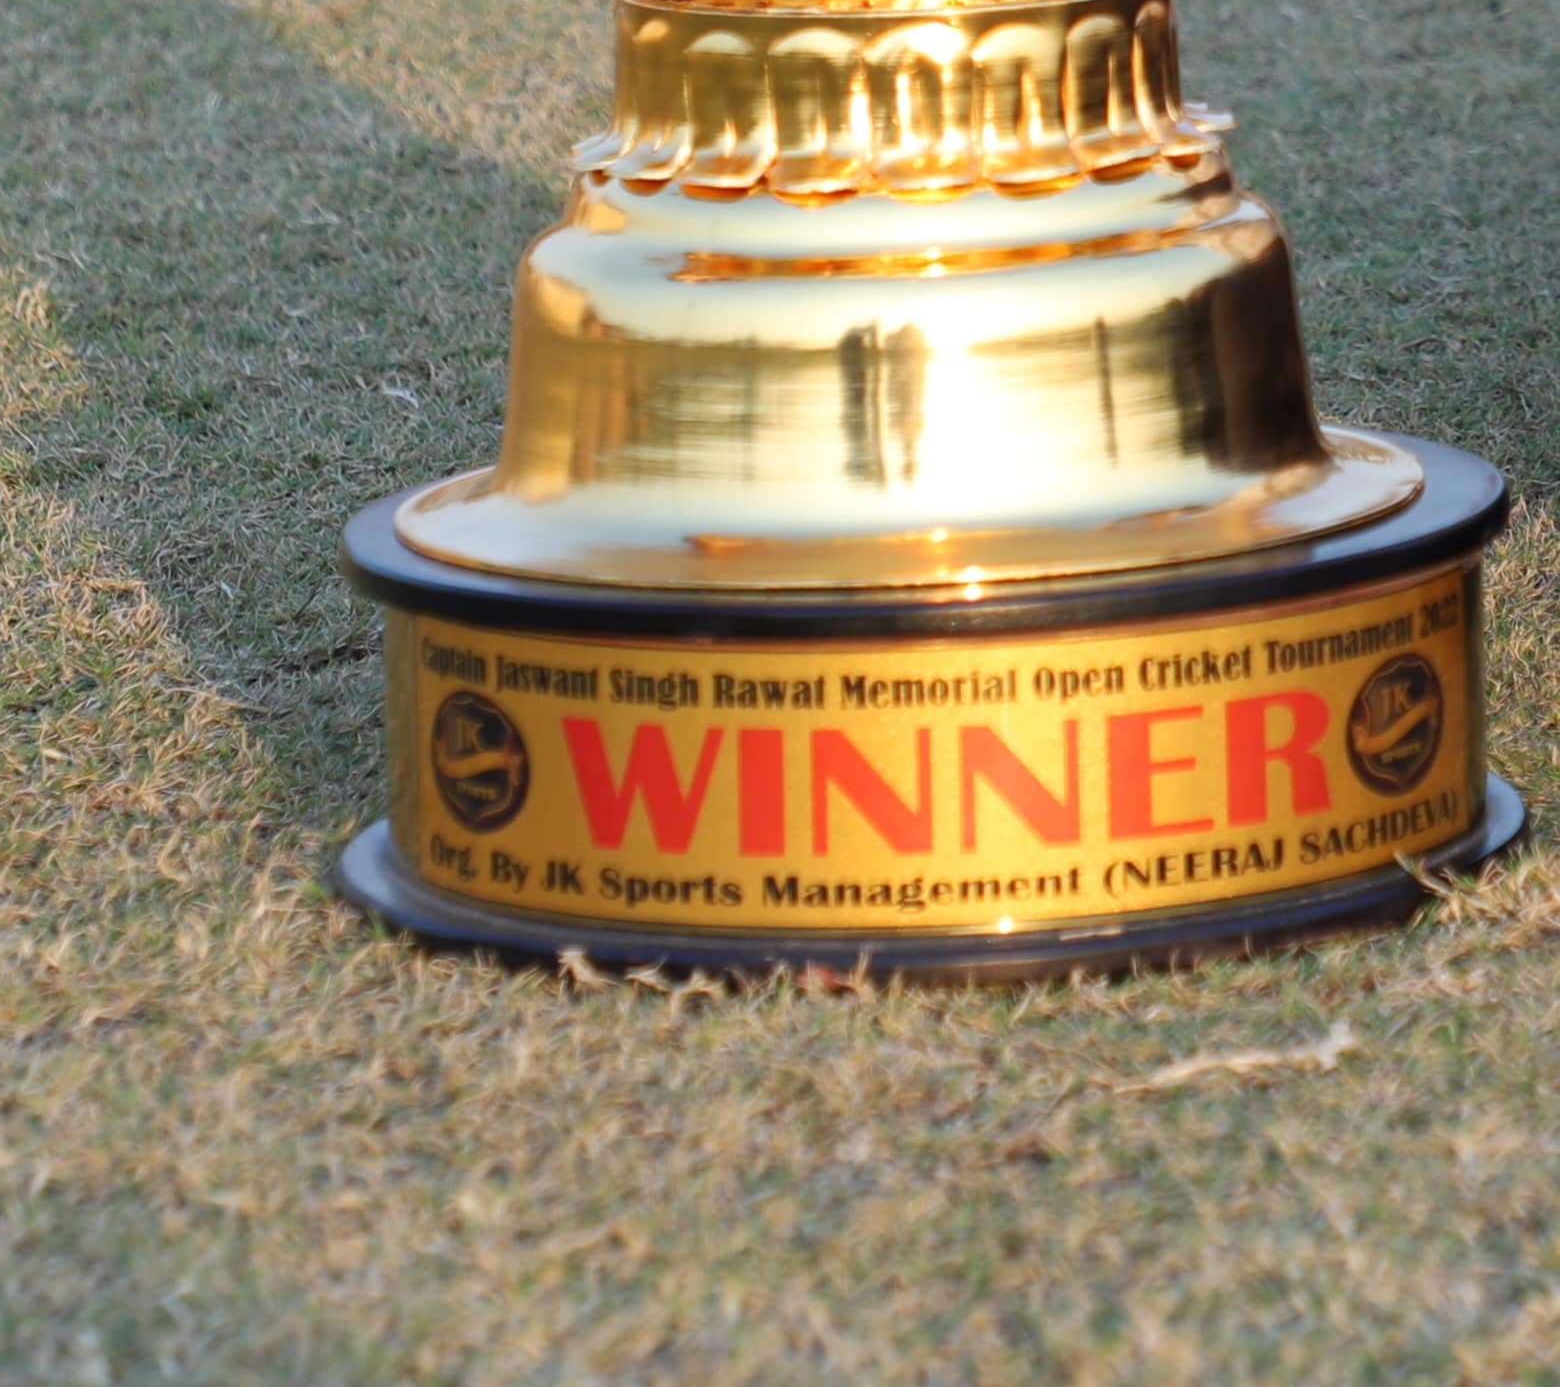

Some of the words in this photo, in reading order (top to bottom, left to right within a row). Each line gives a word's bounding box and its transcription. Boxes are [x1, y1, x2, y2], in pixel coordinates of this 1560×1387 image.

[495, 653, 599, 701] Jaswant
[609, 667, 700, 711] Singh
[712, 674, 826, 711] Rawat
[840, 669, 1018, 711] Memorial
[1033, 663, 1125, 705] Open
[1139, 642, 1252, 693] Cricket
[1263, 609, 1414, 676] Tournament
[560, 689, 1334, 858] WINNER
[430, 835, 477, 882] Org.
[490, 851, 529, 893] By
[541, 861, 585, 896] JK
[598, 868, 744, 909] Sports
[761, 866, 1080, 914] Management
[1103, 836, 1286, 901] (NEERAJ
